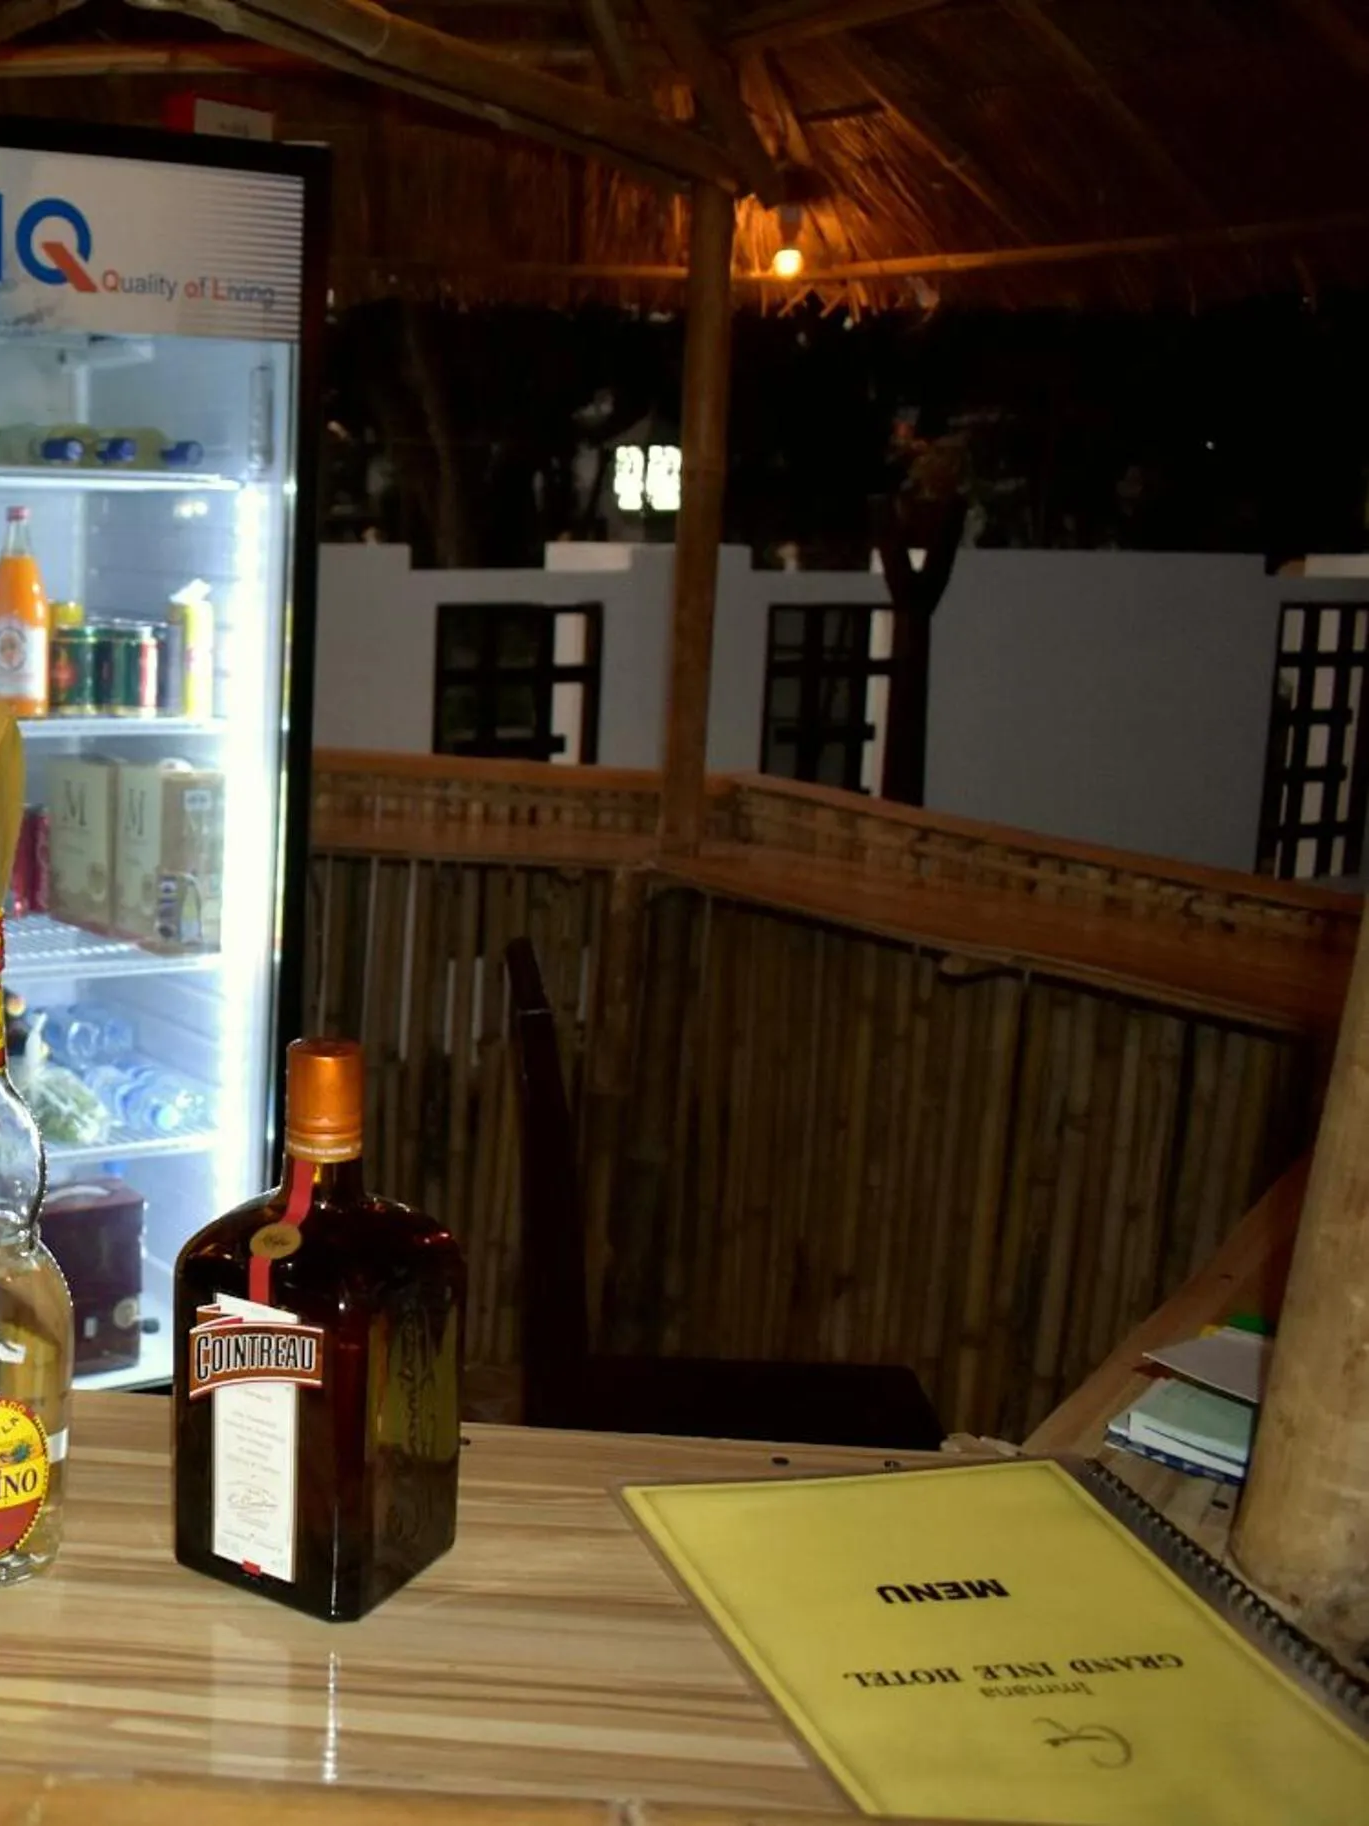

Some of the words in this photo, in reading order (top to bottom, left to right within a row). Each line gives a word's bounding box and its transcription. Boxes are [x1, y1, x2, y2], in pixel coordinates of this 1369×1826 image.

[102, 269, 177, 302] Quality
[184, 276, 208, 299] of
[195, 1333, 315, 1380] COINTREAU
[875, 1578, 1010, 1604] MENU
[972, 1661, 1057, 1681] INLE
[1069, 1653, 1184, 1676] GRAND
[843, 1667, 964, 1688] HOTEL
